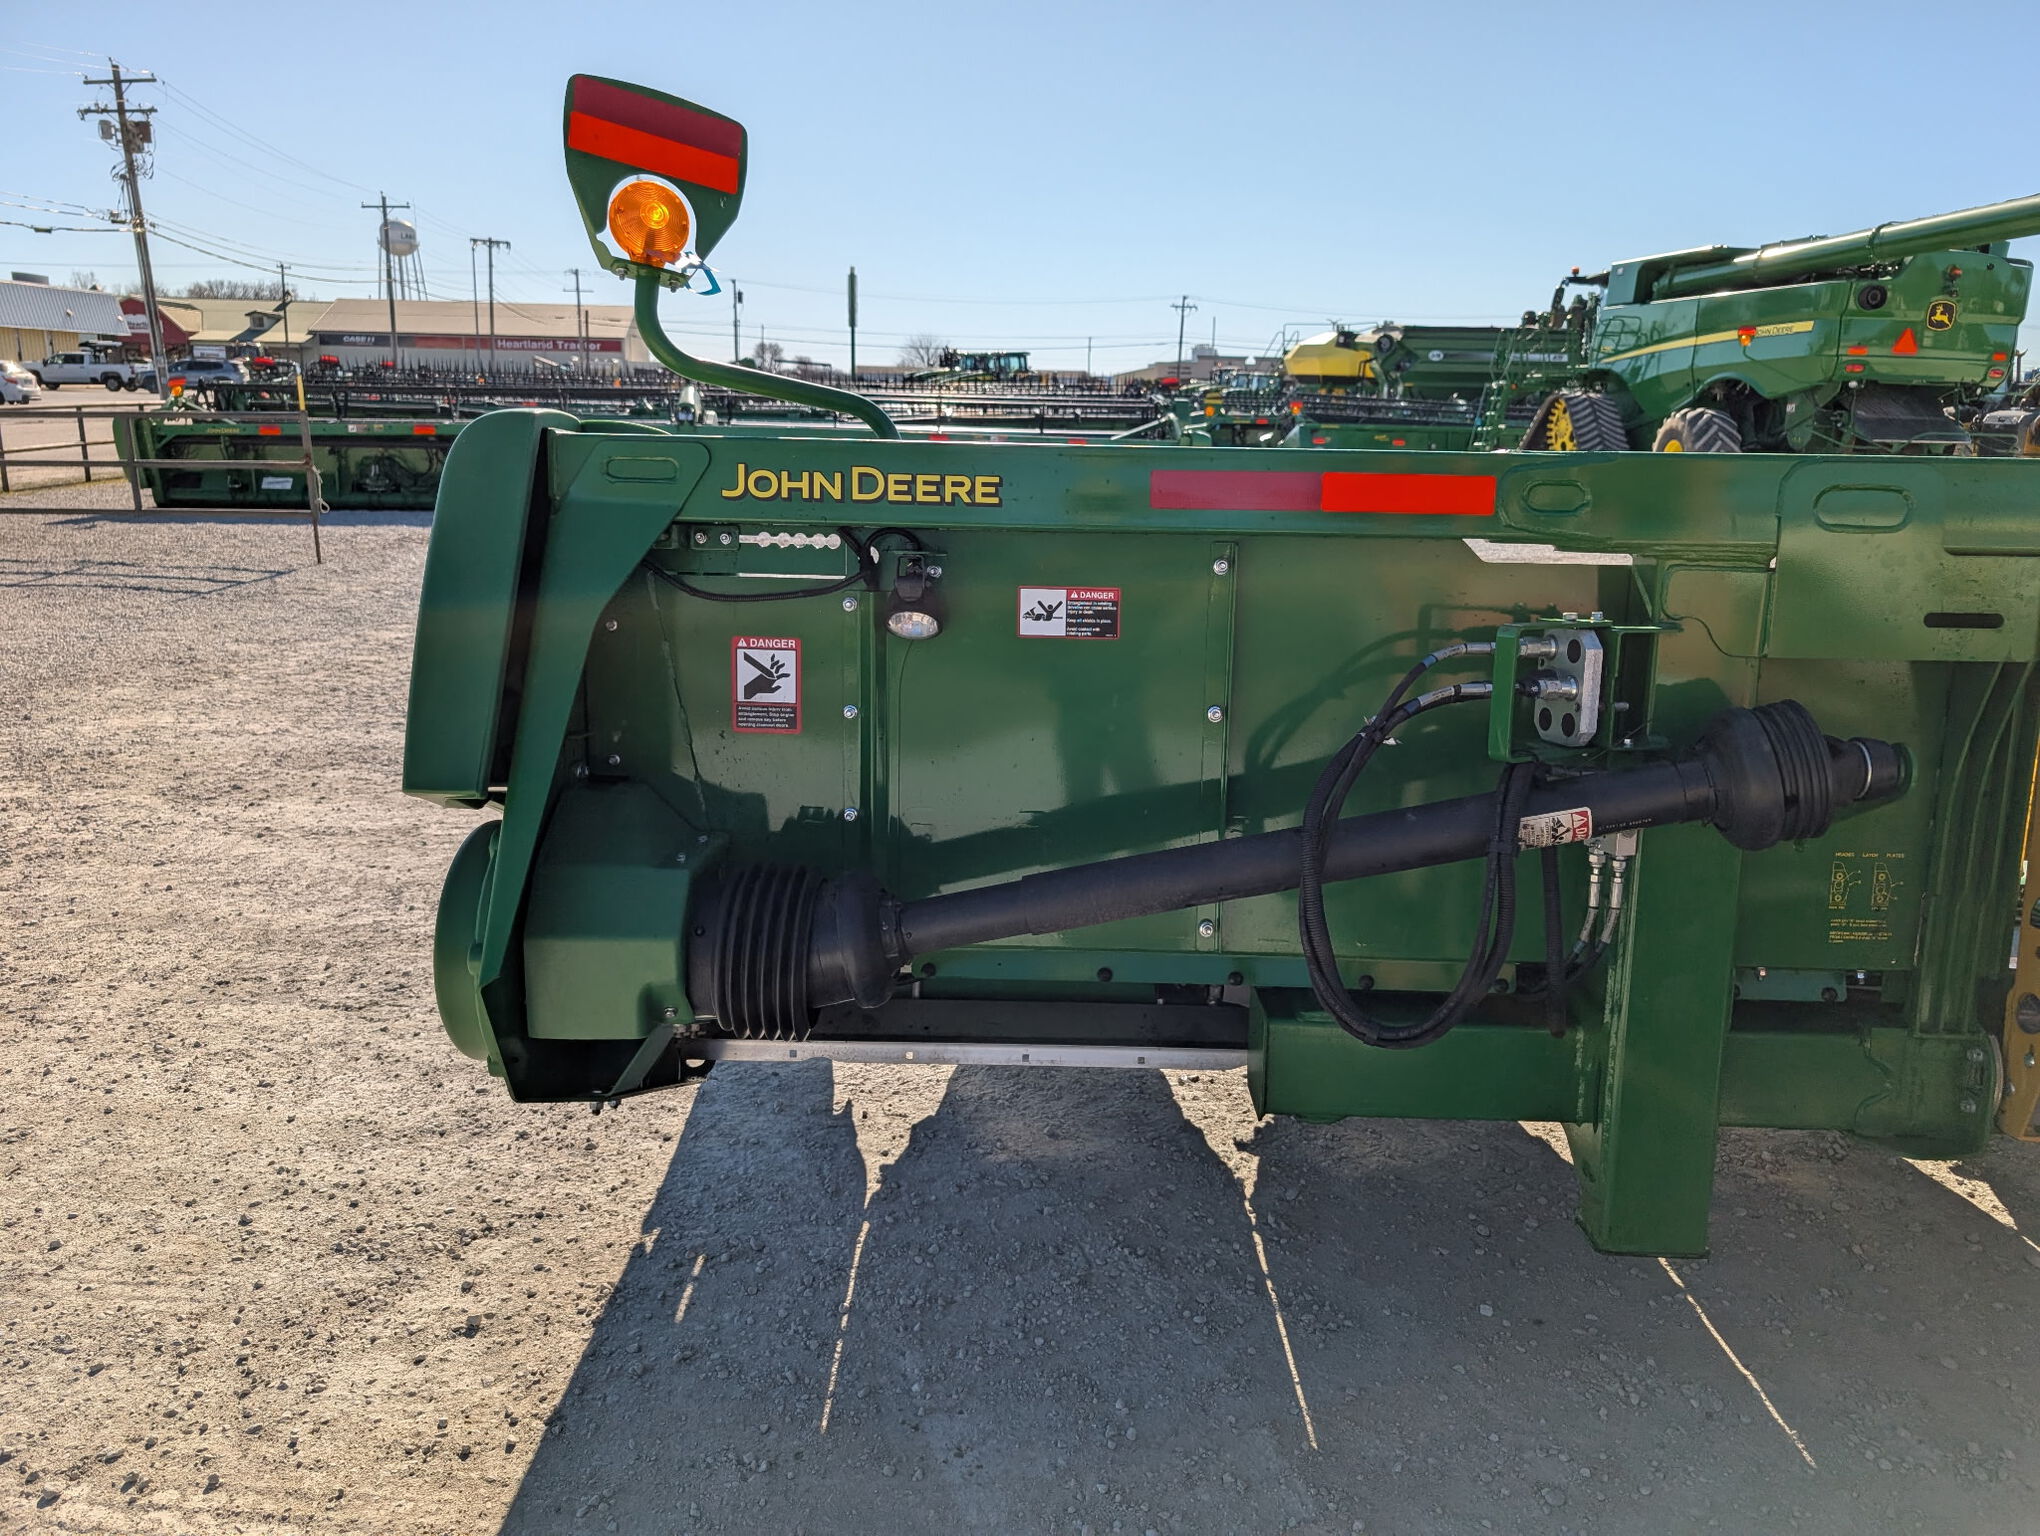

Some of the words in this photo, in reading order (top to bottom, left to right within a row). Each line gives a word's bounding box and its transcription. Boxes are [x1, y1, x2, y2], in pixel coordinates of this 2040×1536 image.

[343, 335, 366, 343] CASE
[497, 339, 553, 349] Heartland
[720, 462, 844, 501] JOHN
[851, 465, 1003, 507] DEERE
[1080, 591, 1114, 599] DANGER
[750, 638, 796, 648] DANGER
